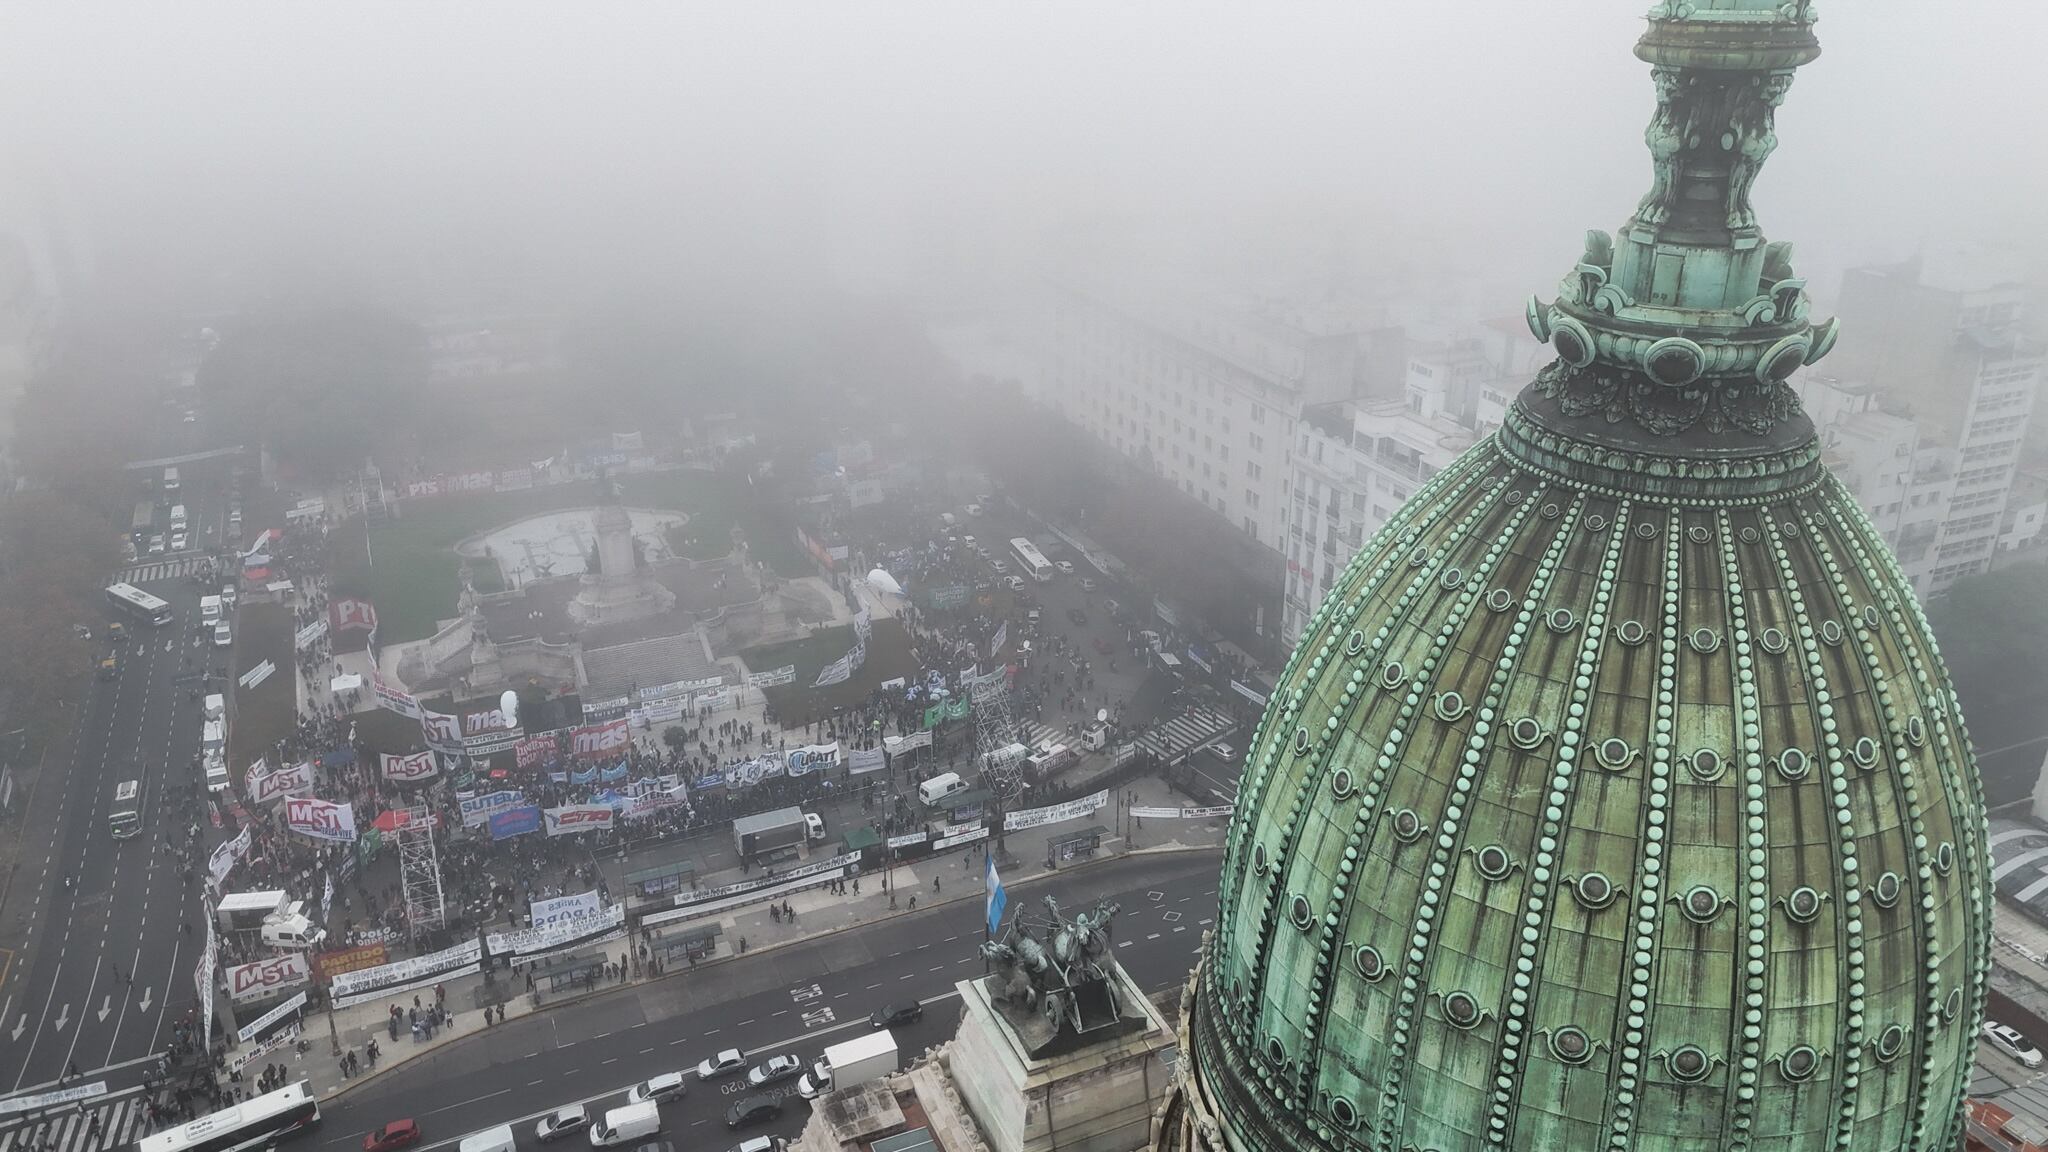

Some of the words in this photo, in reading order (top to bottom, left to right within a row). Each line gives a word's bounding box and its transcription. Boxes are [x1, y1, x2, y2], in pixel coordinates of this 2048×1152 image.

[468, 709, 505, 731] ma
[574, 725, 626, 754] mas
[389, 757, 430, 776] MST
[262, 774, 302, 796] MST
[291, 803, 337, 831] MST
[360, 926, 391, 939] POLO
[321, 946, 384, 969] PARTIDO
[239, 962, 294, 990] MST
